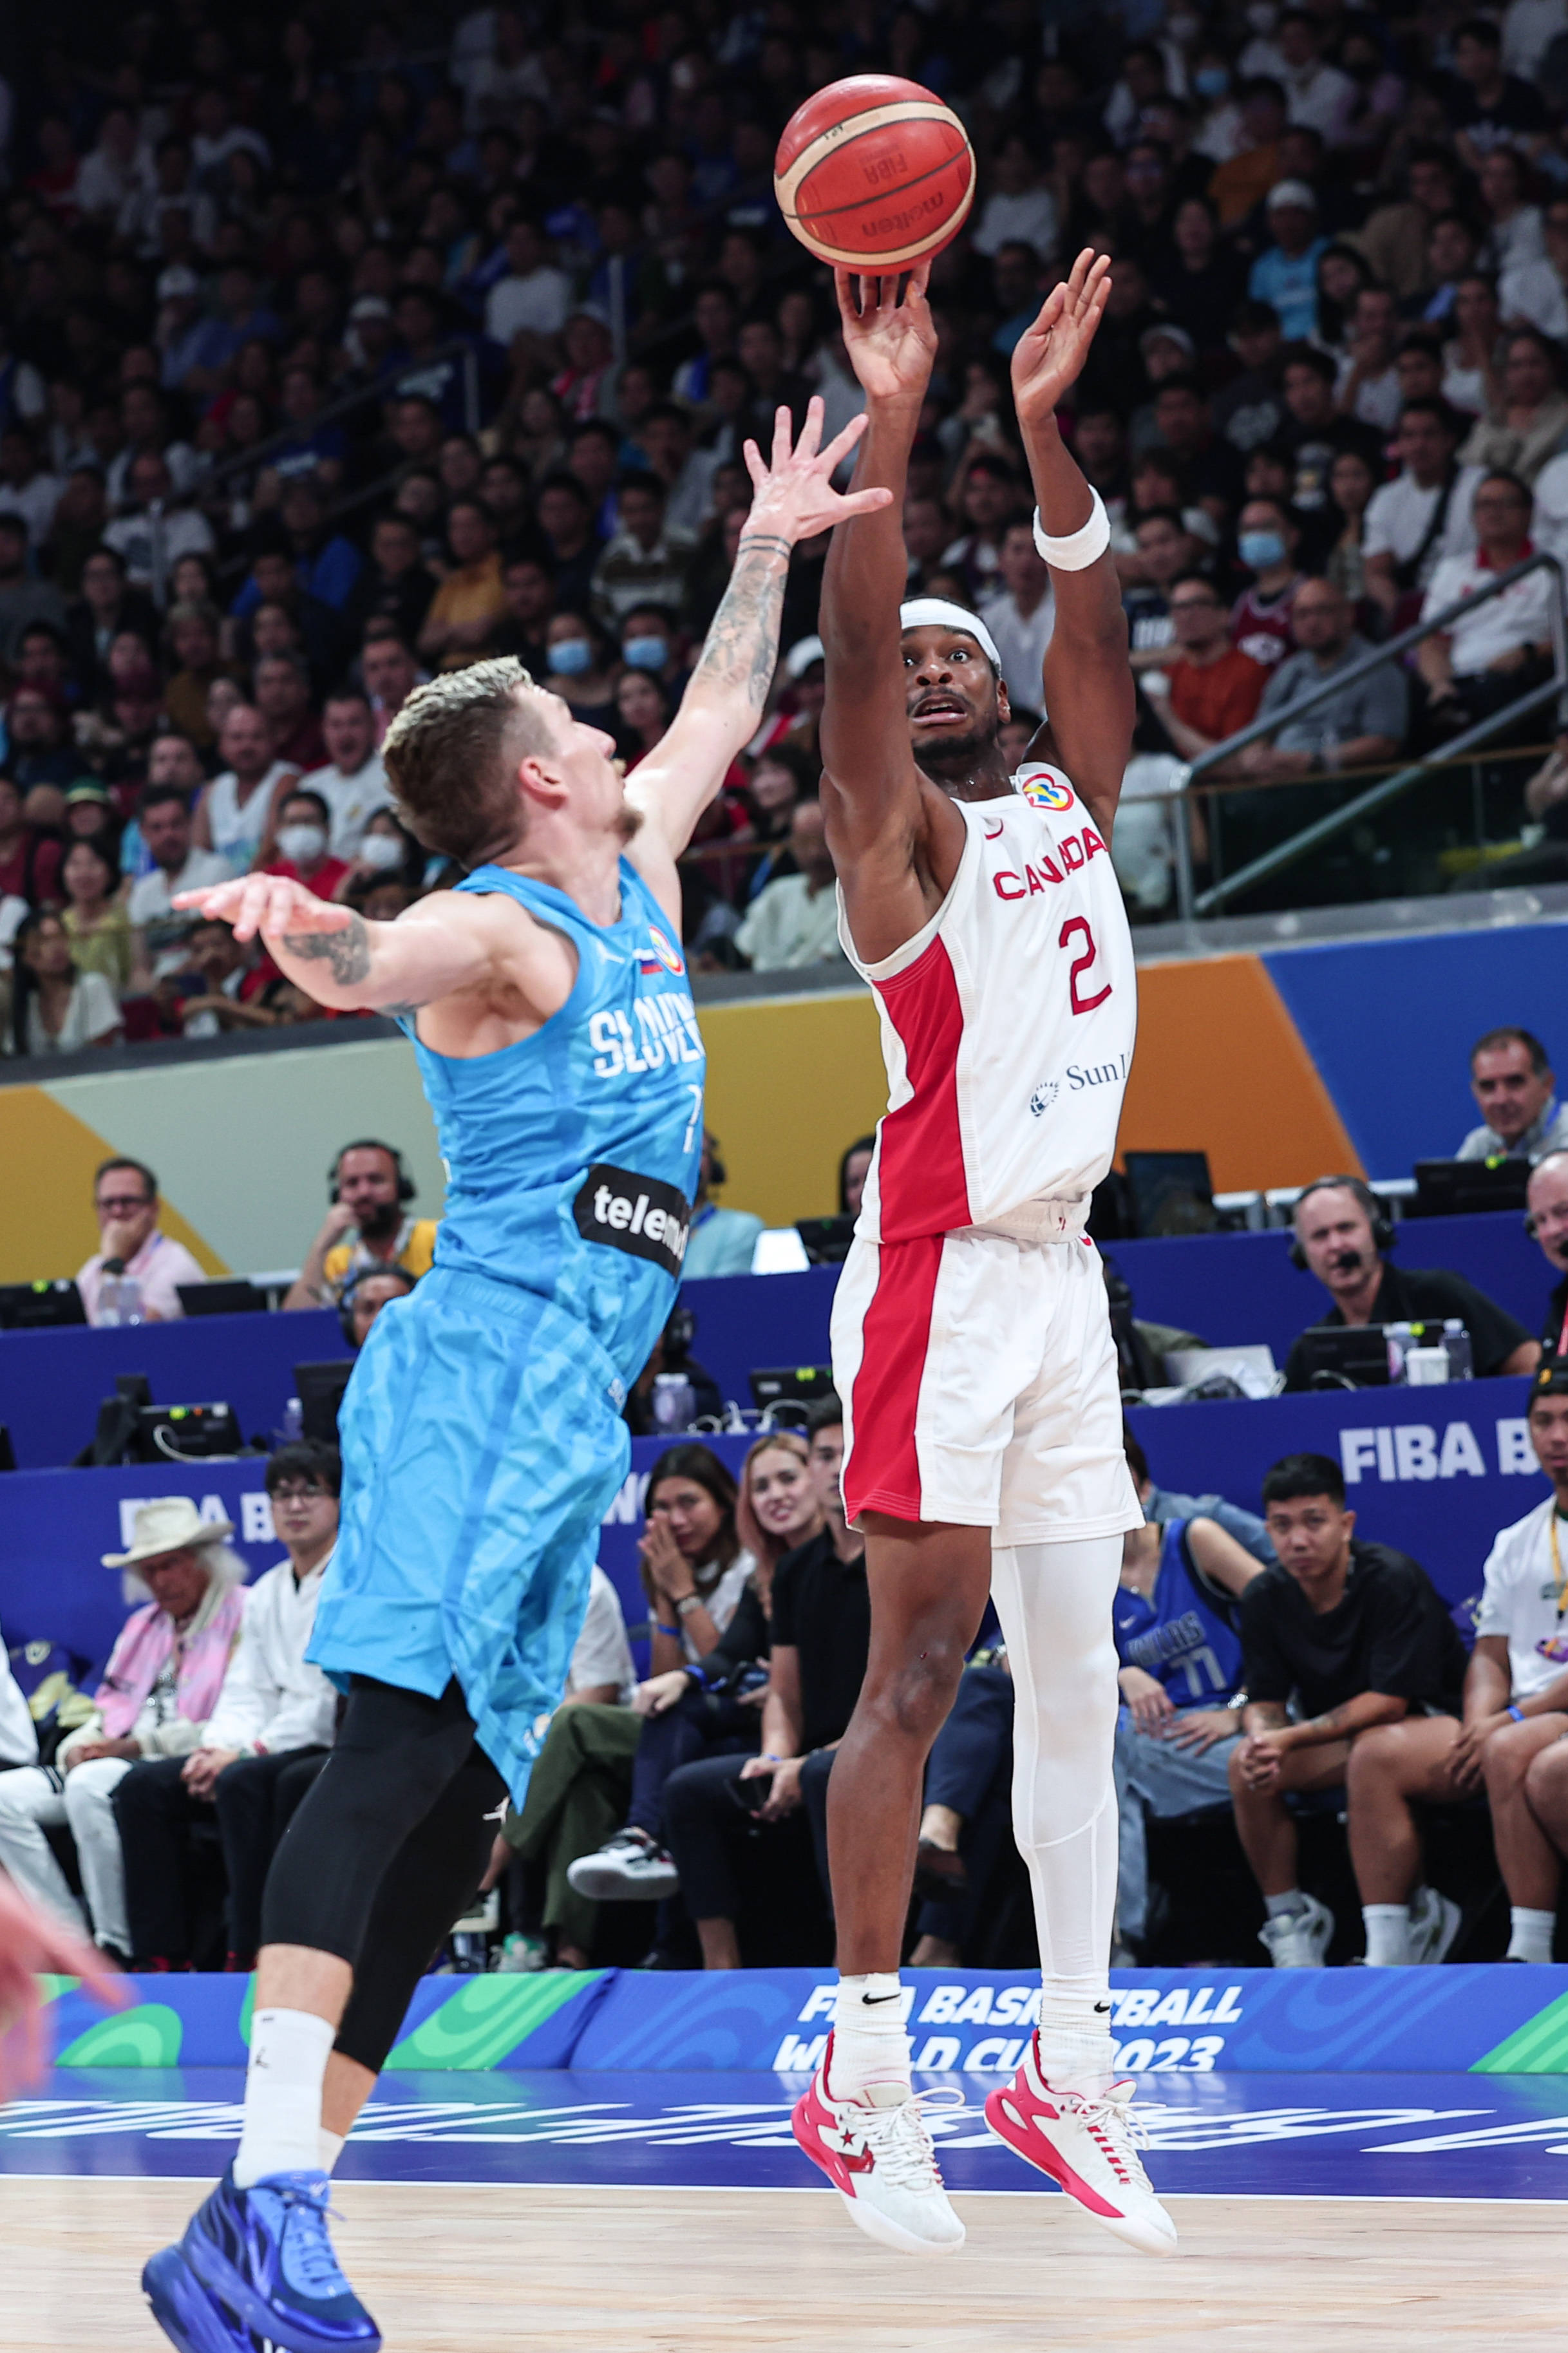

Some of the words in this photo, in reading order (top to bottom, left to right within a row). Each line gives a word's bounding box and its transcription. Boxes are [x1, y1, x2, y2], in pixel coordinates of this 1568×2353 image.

[863, 153, 908, 185] FIBA
[862, 192, 943, 237] molten
[1059, 916, 1113, 1016] 2
[1339, 1421, 1486, 1484] FIBA
[119, 1493, 234, 1549] FA
[1169, 1645, 1227, 1697] 77
[963, 2037, 1036, 2072] CU
[1114, 2036, 1224, 2072] 023
